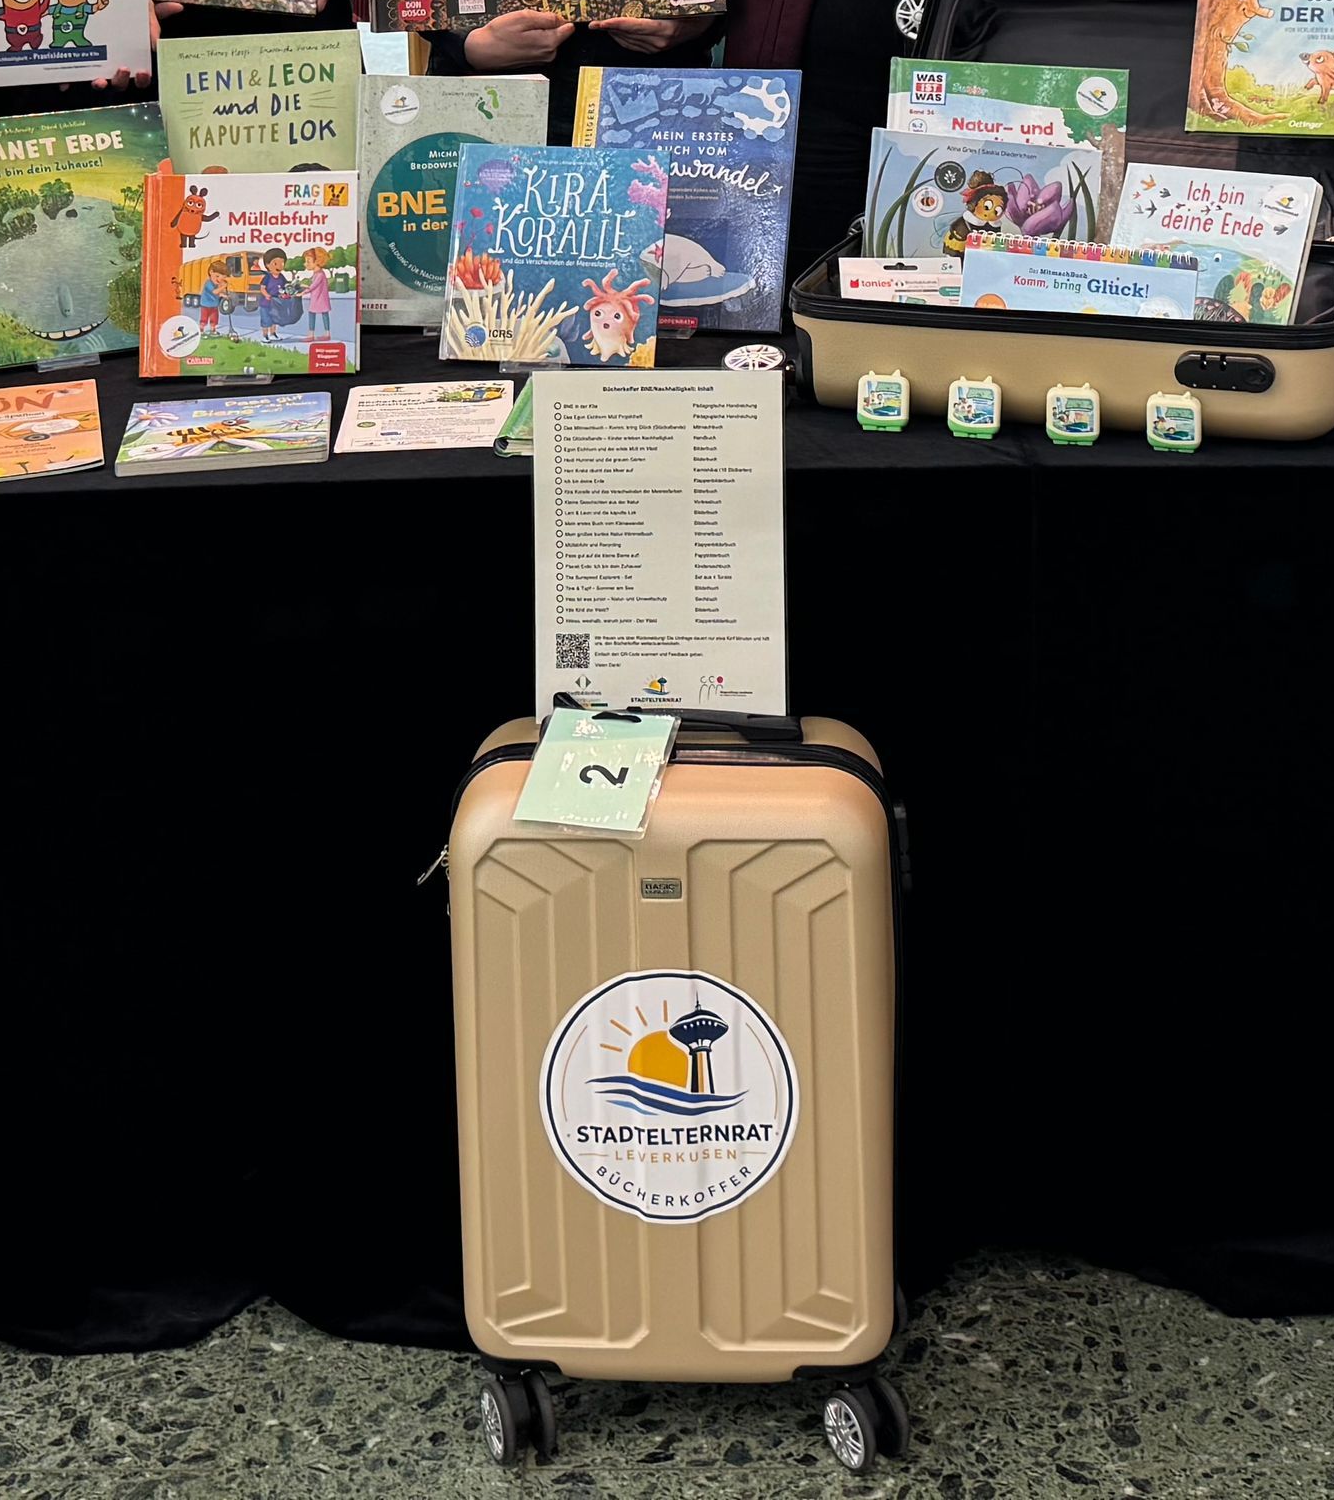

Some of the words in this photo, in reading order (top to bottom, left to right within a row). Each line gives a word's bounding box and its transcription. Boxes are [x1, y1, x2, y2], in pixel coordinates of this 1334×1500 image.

[401, 9, 426, 17] BOSCO
[1280, 7, 1324, 22] DER
[186, 69, 244, 95] LENI
[248, 68, 262, 87] &
[268, 62, 335, 88] LEON
[917, 74, 943, 82] WAS
[915, 92, 942, 101] WAS
[920, 83, 938, 92] IST
[213, 96, 258, 117] und
[270, 93, 302, 116] DIE
[584, 103, 595, 148] EILIGERS
[951, 117, 1013, 133] Natur-
[1020, 122, 1054, 136] und
[1288, 119, 1323, 130] Oettinger
[65, 130, 124, 155] ERDE
[189, 123, 280, 149] KAPUTTE
[289, 119, 337, 145] LOK
[652, 131, 685, 140] MEIN
[692, 131, 734, 142] ERSTES
[429, 150, 460, 159] MICHA
[699, 146, 727, 156] VOM
[5, 167, 24, 177] bin
[27, 164, 52, 174] dein
[55, 156, 103, 171] Zuhause!
[410, 162, 459, 171] BRODOWSK
[670, 160, 769, 197] awandel
[284, 184, 320, 199] FRAG
[523, 165, 613, 218] KIRA
[1187, 180, 1211, 202] Ich
[1219, 183, 1245, 205] bin
[377, 189, 447, 217] BNE
[228, 211, 328, 226] Müllabfuhr
[403, 219, 416, 232] in
[421, 219, 448, 231] der
[1161, 209, 1214, 233] deine
[1221, 212, 1264, 237] Erde
[220, 233, 245, 244] und
[250, 228, 335, 246] Recycling
[487, 197, 637, 261] KORALLE
[525, 258, 565, 267] Verschwinden
[1013, 275, 1049, 289] Komm,
[1053, 279, 1081, 294] bring
[1087, 277, 1149, 299] Glück!
[489, 329, 513, 339] ICRS
[579, 764, 629, 788] 2
[577, 1124, 773, 1146] STADTELTERNRAT
[615, 1149, 738, 1163] LEVERKUSEN
[596, 1165, 752, 1207] BÜCHERKOFFER
